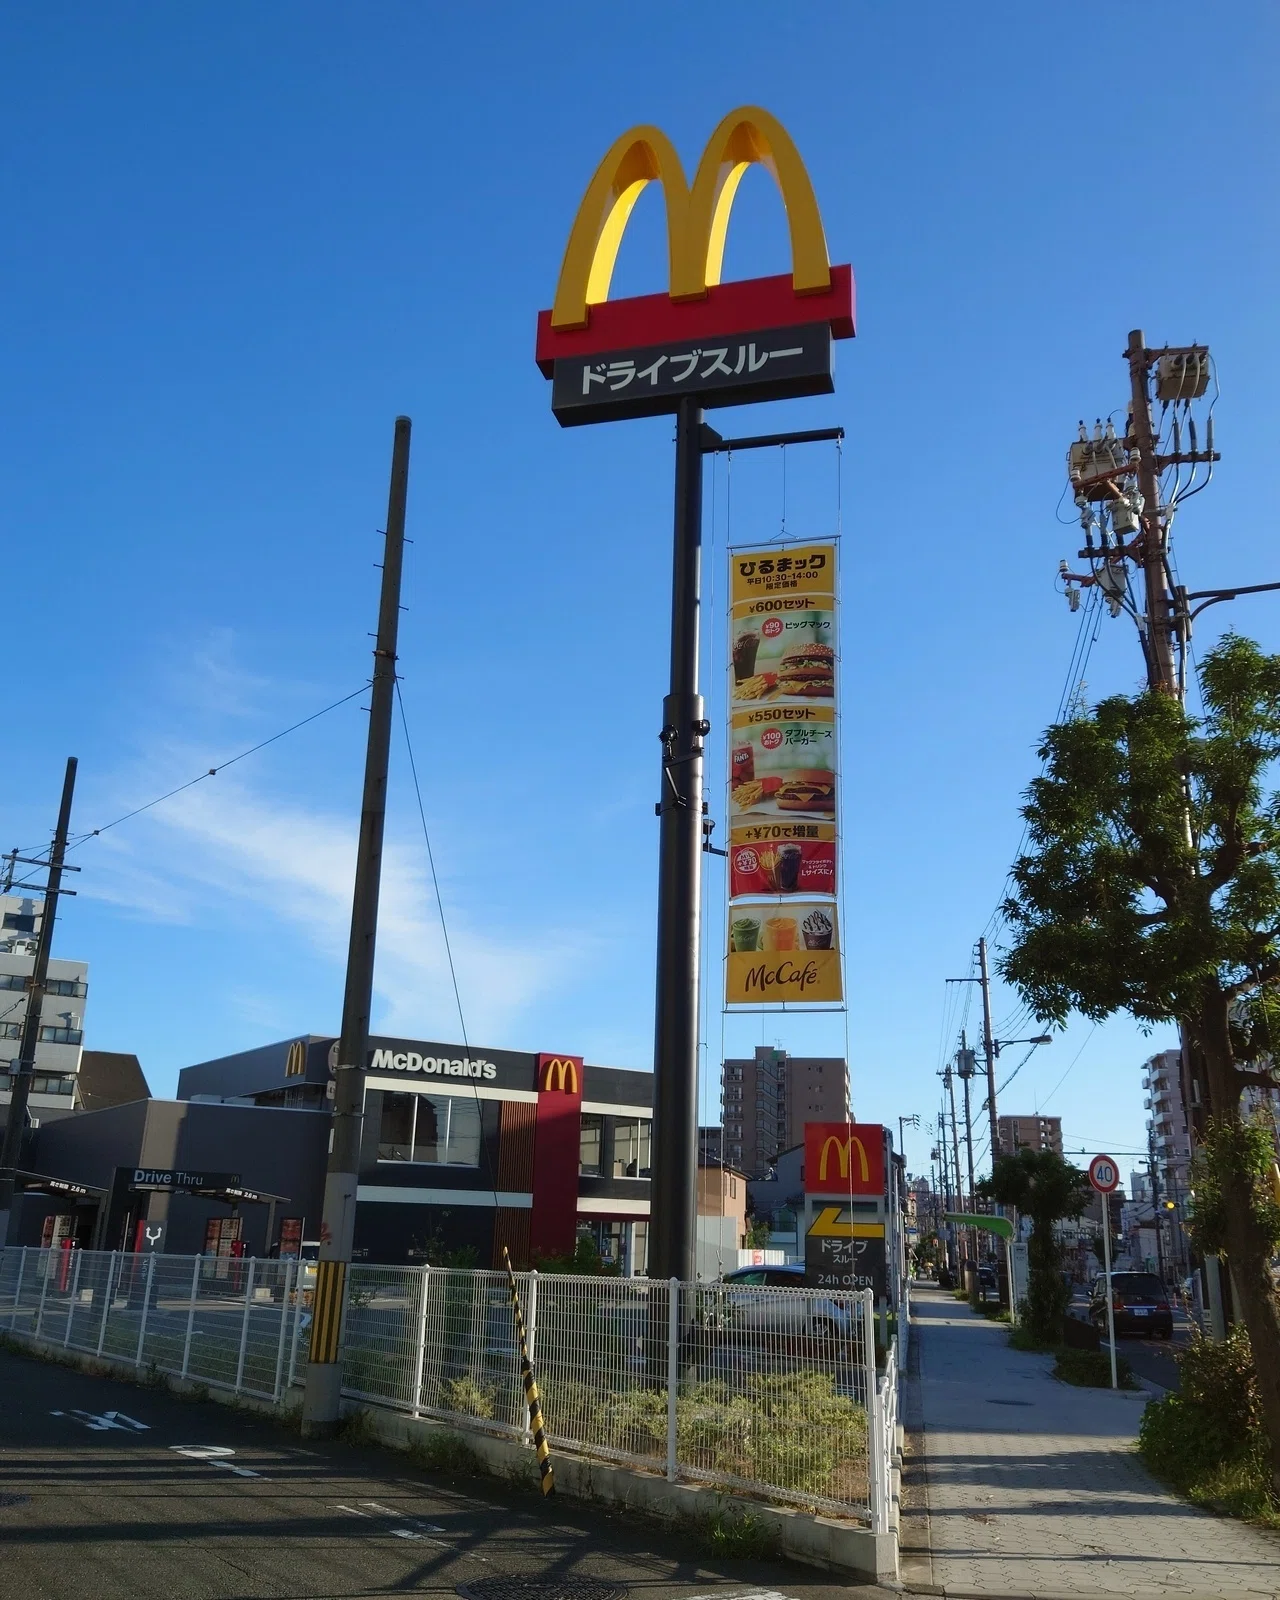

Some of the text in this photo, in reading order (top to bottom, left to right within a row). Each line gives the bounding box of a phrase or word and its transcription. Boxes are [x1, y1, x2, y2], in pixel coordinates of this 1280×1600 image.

[582, 342, 803, 395] ドライブスルー
[740, 554, 826, 576] ひるまック
[765, 580, 798, 590] 限定価格
[749, 598, 815, 613] ¥600セット
[785, 621, 831, 630] ビッグマック
[749, 708, 816, 723] ¥550セット
[785, 729, 833, 738] ダブルチーズ
[785, 737, 817, 745] バーガー
[744, 960, 818, 993] McCafé
[371, 1049, 497, 1080] McDonald's
[133, 1169, 204, 1185] Drive Thru
[1096, 1165, 1113, 1182] 40
[821, 1239, 868, 1254] ドライブ
[832, 1254, 858, 1264] スルー
[818, 1274, 874, 1286] 24h OPEN
